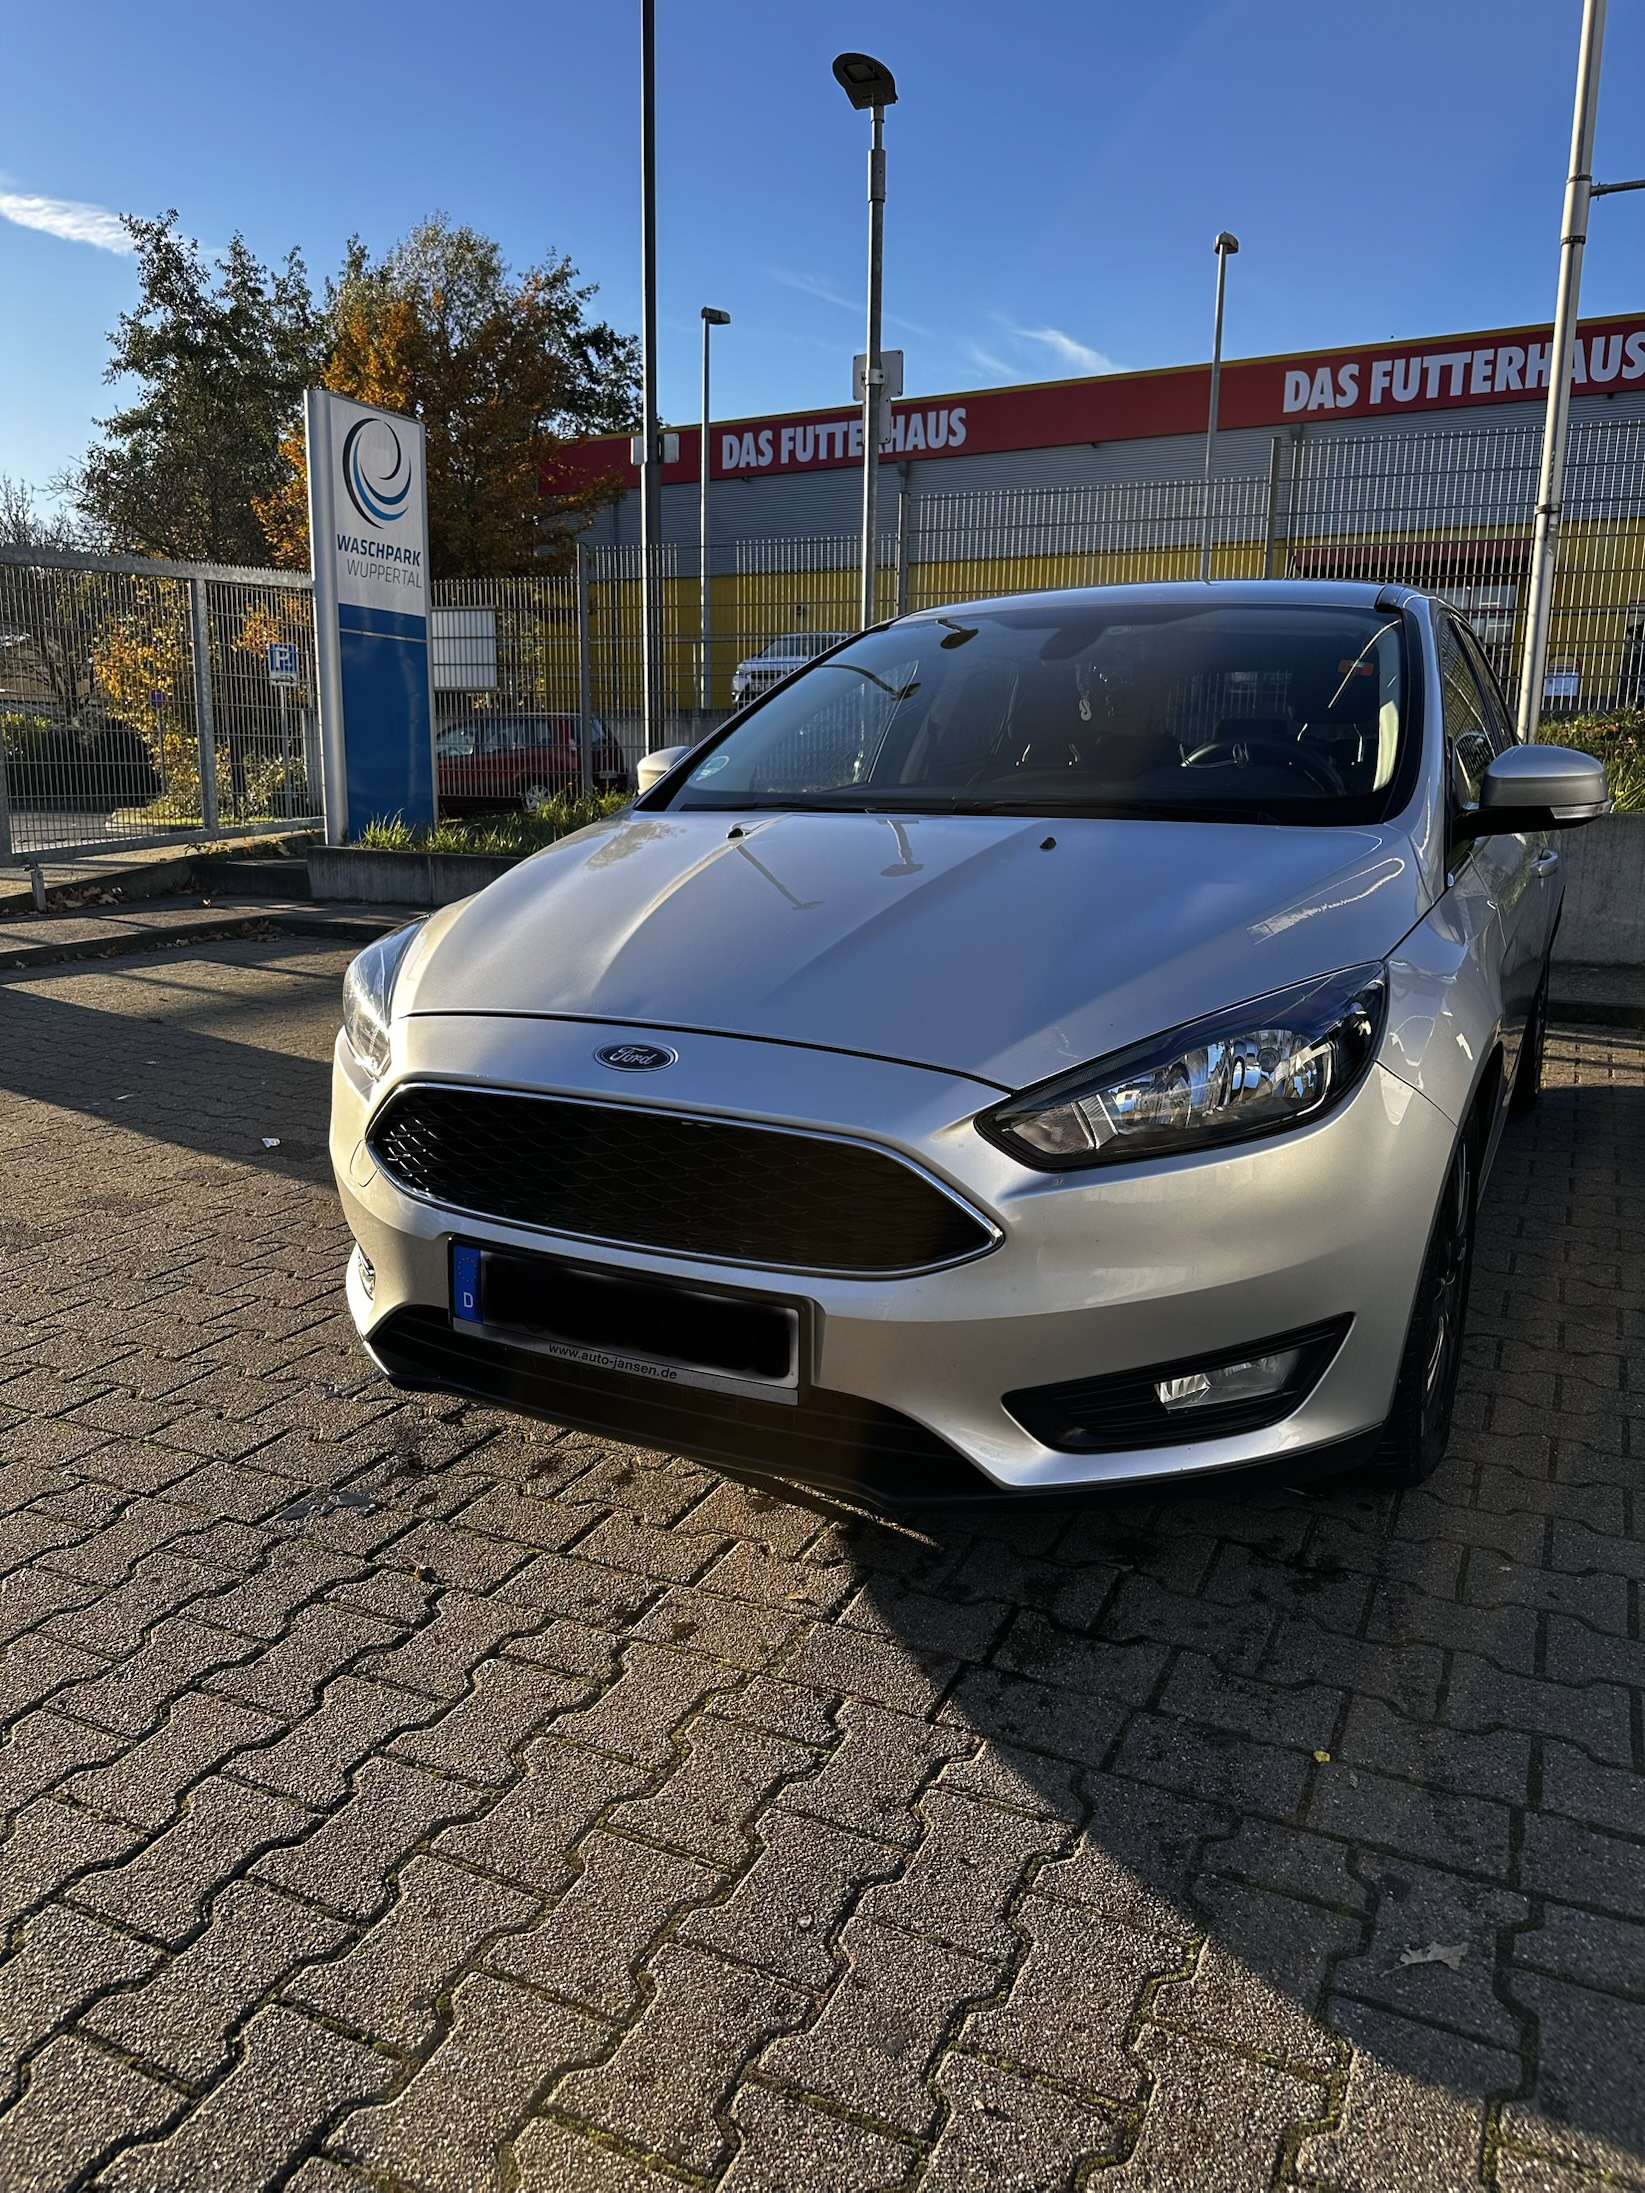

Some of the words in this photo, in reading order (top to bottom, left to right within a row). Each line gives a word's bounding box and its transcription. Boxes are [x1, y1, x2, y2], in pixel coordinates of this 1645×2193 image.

[1282, 363, 1359, 413] DAS
[722, 430, 774, 470] DAS
[780, 408, 967, 464] FUTTEHAUS
[337, 533, 422, 567] WASCHPARK
[347, 558, 423, 589] WUPPERTAL
[609, 1046, 657, 1065] Ford
[463, 1291, 474, 1308] D
[548, 1343, 677, 1379] www.auto-jansen.de
